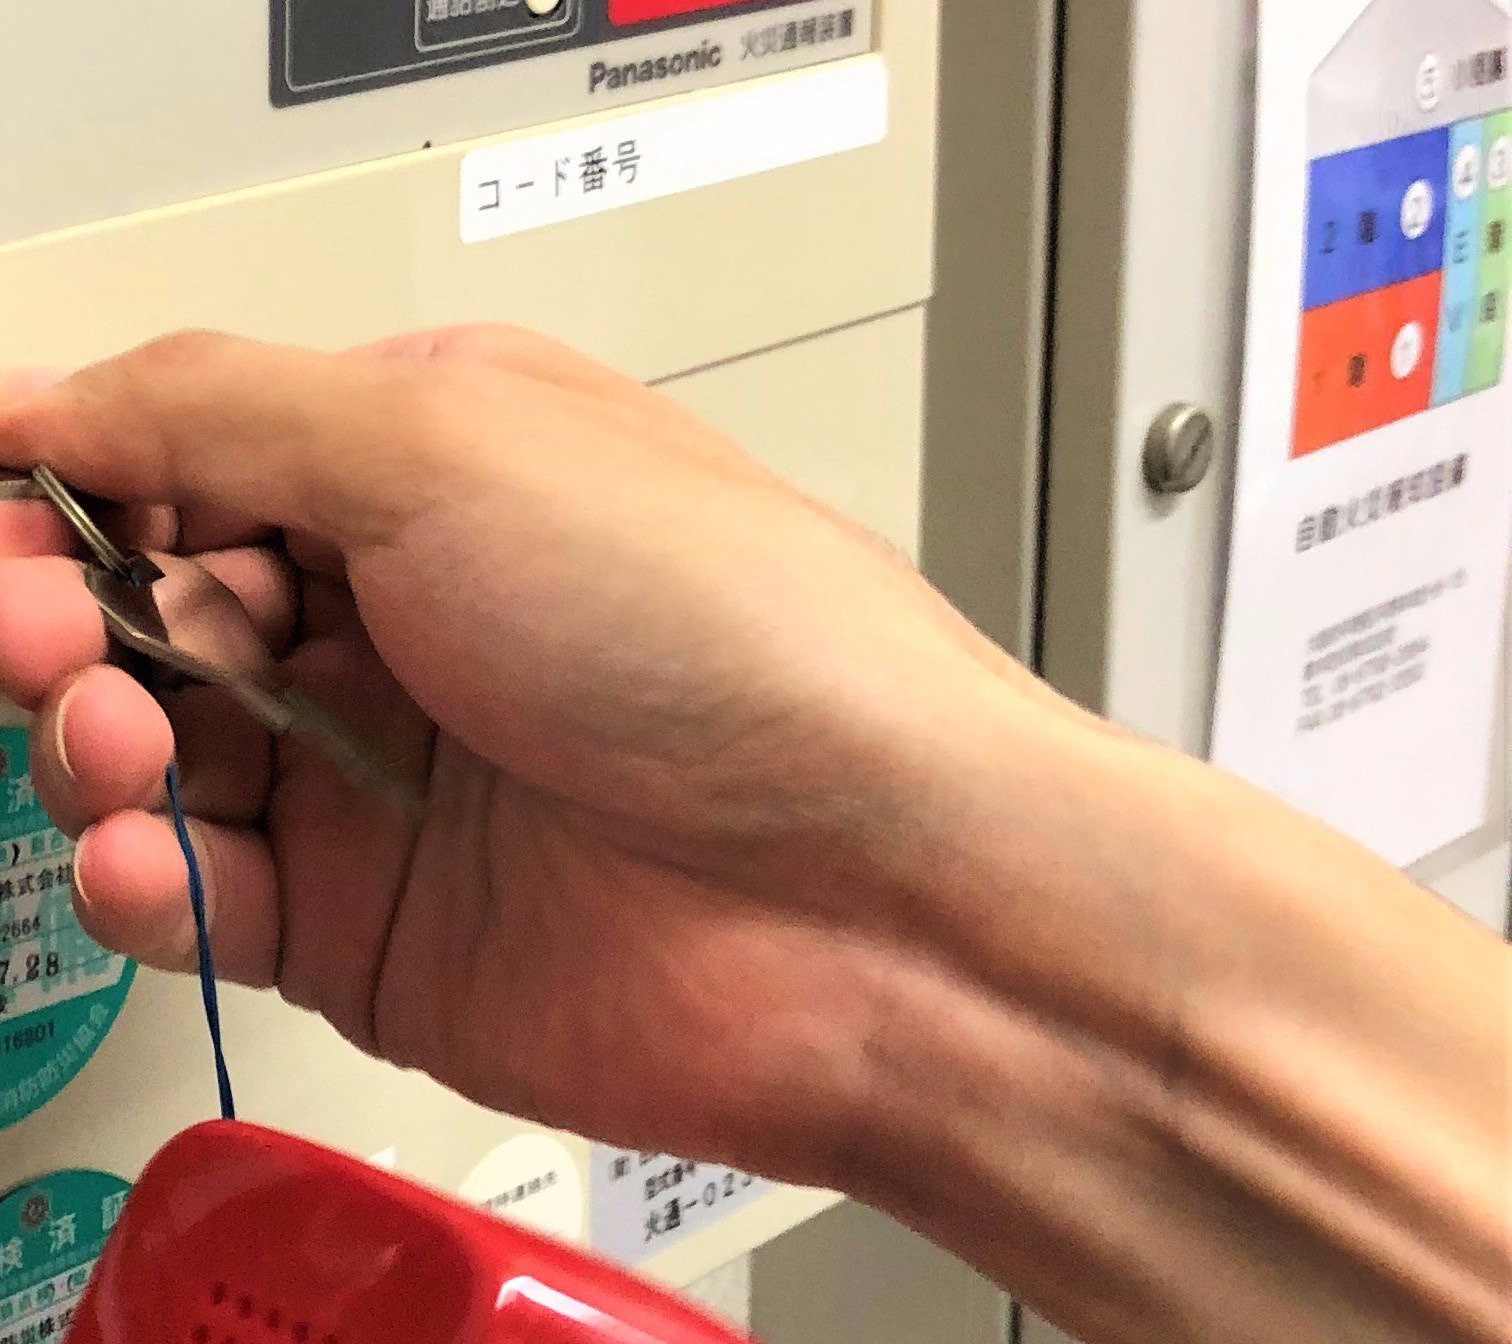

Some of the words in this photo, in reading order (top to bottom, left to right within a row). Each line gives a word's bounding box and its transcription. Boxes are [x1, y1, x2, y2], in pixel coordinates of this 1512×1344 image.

[589, 39, 723, 93] Panasonic
[478, 139, 642, 211] コード番号
